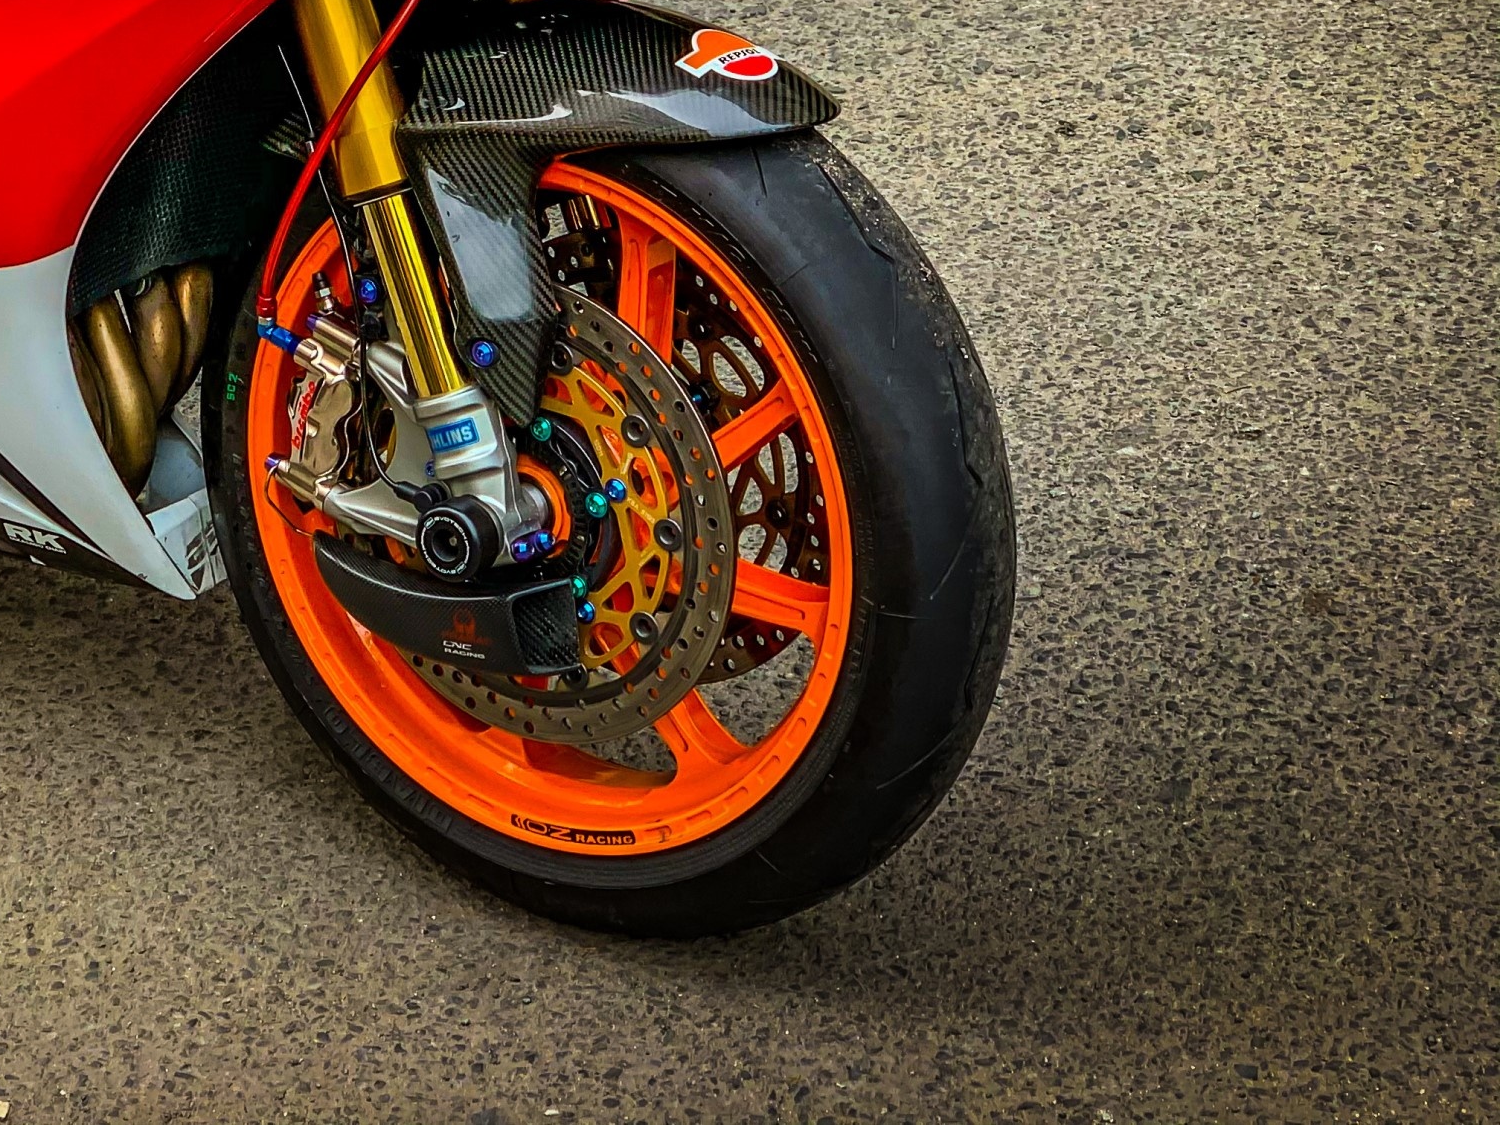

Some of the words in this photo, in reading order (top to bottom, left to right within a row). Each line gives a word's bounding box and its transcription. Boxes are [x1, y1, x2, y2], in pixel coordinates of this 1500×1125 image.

[718, 48, 761, 64] REPSOL
[292, 381, 316, 450] brembo
[3, 523, 65, 551] RK
[444, 648, 486, 659] RACING
[575, 833, 634, 845] RACING
